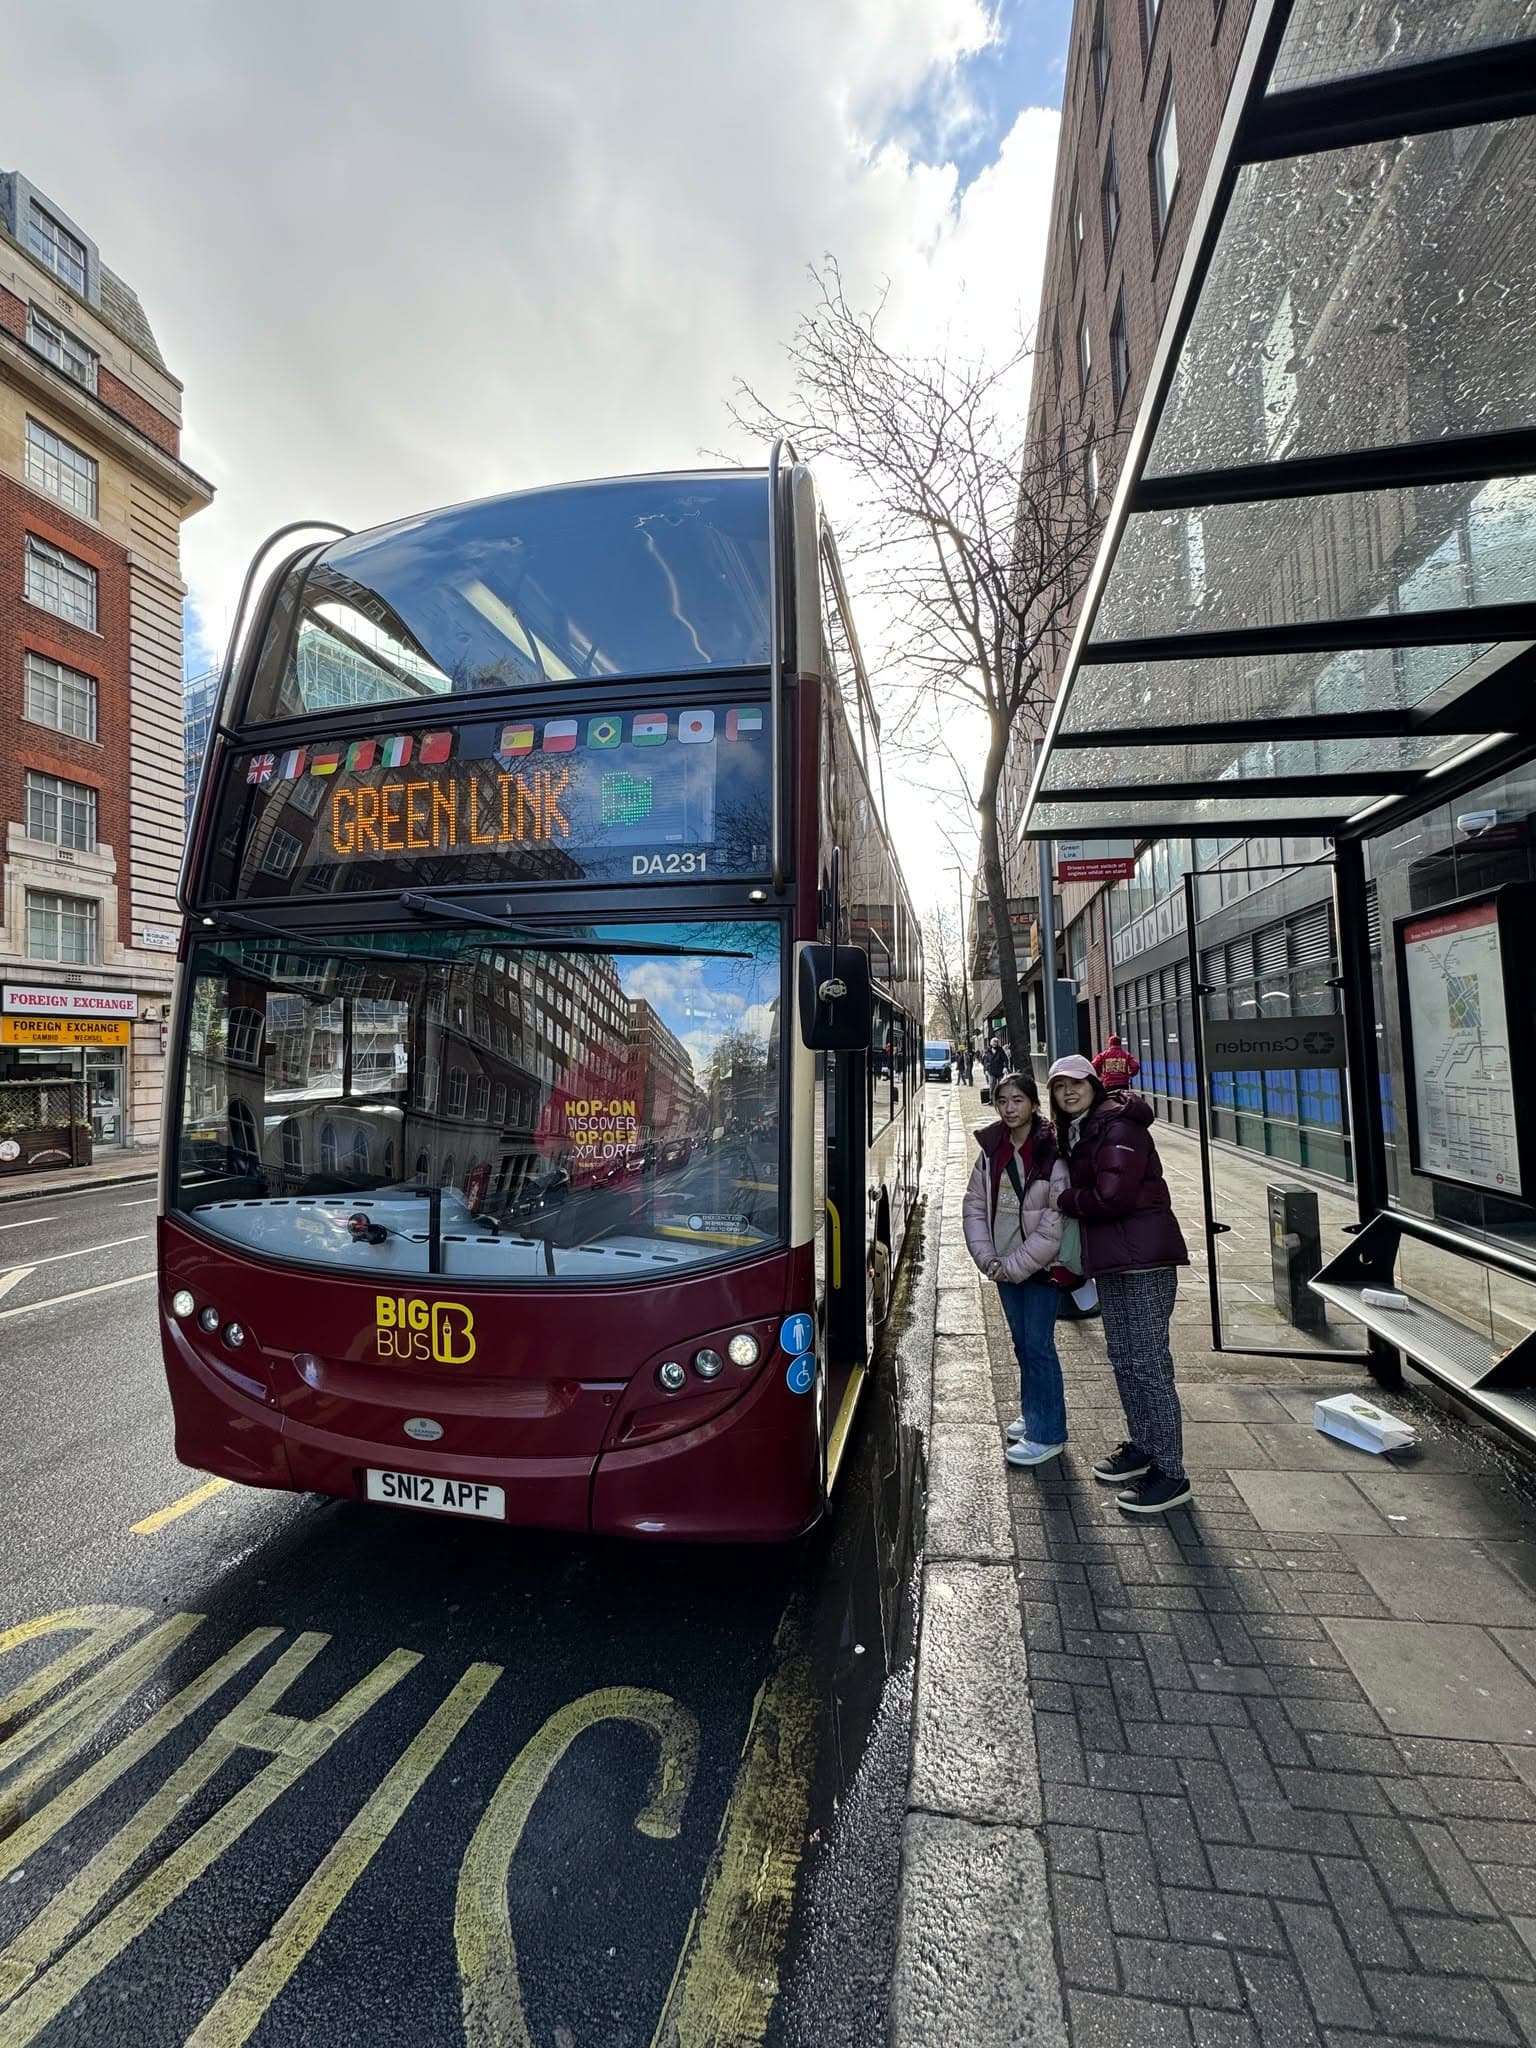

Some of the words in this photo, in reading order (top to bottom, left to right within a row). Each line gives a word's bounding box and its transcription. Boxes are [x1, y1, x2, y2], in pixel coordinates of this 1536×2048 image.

[332, 778, 456, 854] GREEN
[470, 767, 571, 844] LINK
[632, 852, 708, 875] DA231
[10, 993, 69, 1008] FOREIGN
[73, 996, 134, 1010] EXCHANGE
[13, 1020, 62, 1032] FOREIGN
[67, 1022, 120, 1033] EXCHANGE
[565, 1100, 636, 1117] HOP-ON
[570, 1144, 637, 1159] XPLORE
[376, 1295, 429, 1331] BIG
[376, 1328, 431, 1361] BUS
[381, 1473, 435, 1504] SN12
[442, 1482, 489, 1510] APF
